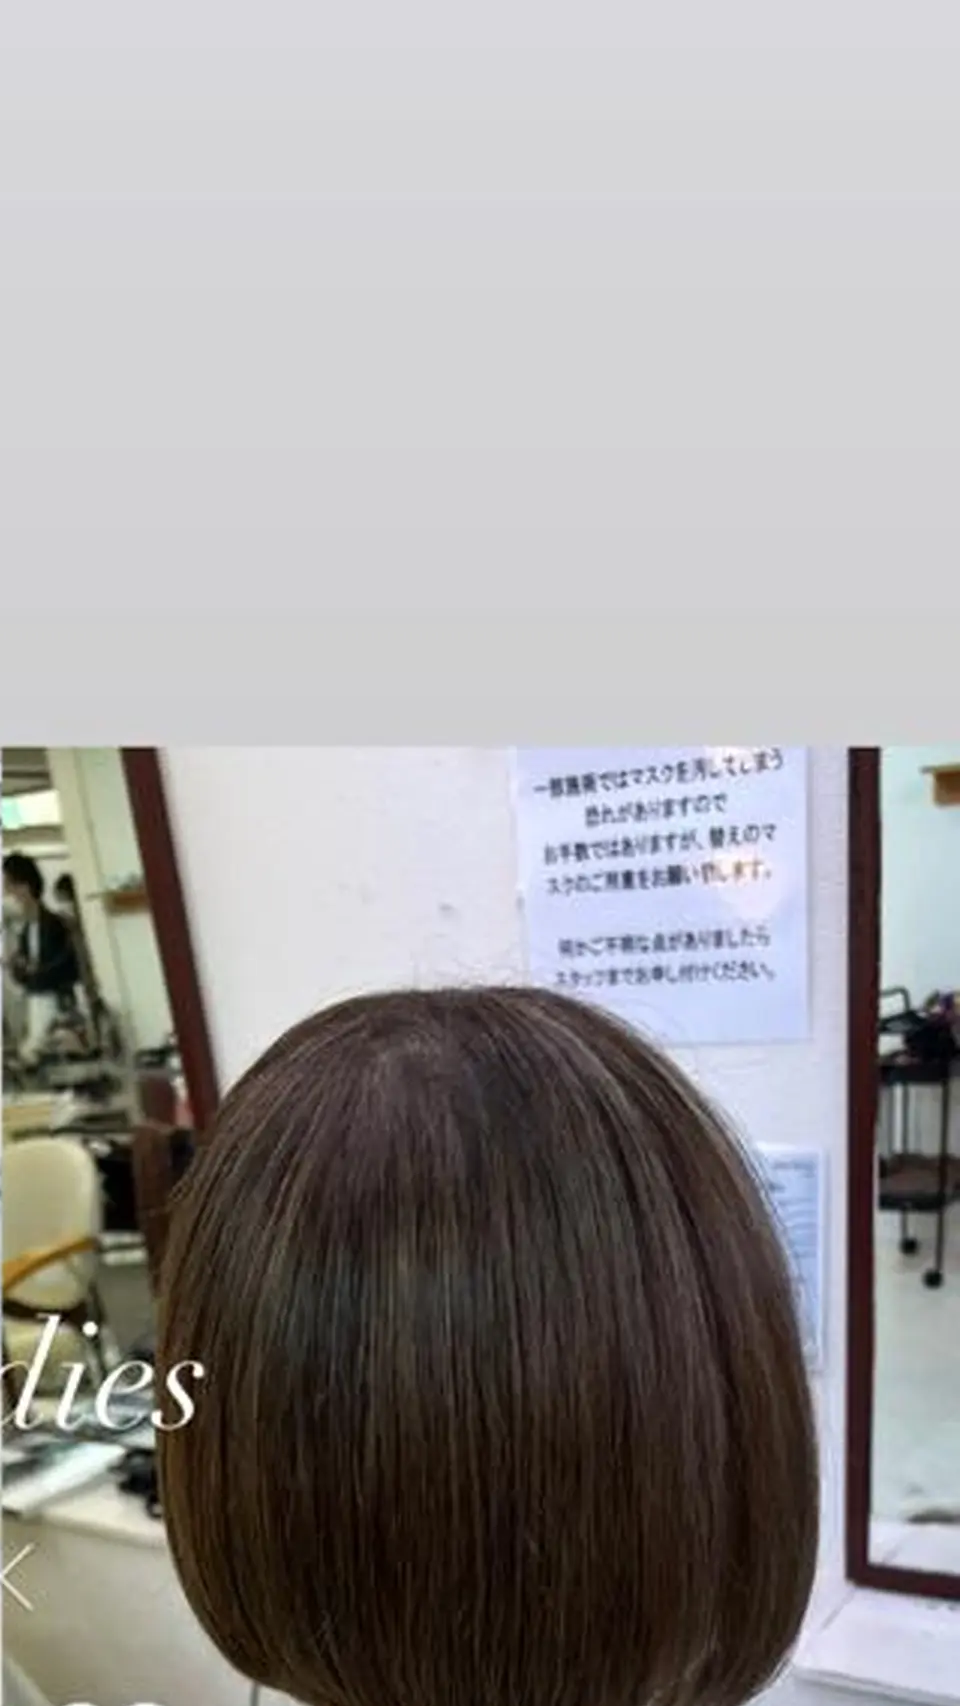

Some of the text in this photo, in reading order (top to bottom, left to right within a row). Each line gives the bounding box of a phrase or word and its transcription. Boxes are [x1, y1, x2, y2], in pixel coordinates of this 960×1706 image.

[585, 793, 728, 827] 恐れがありますので
